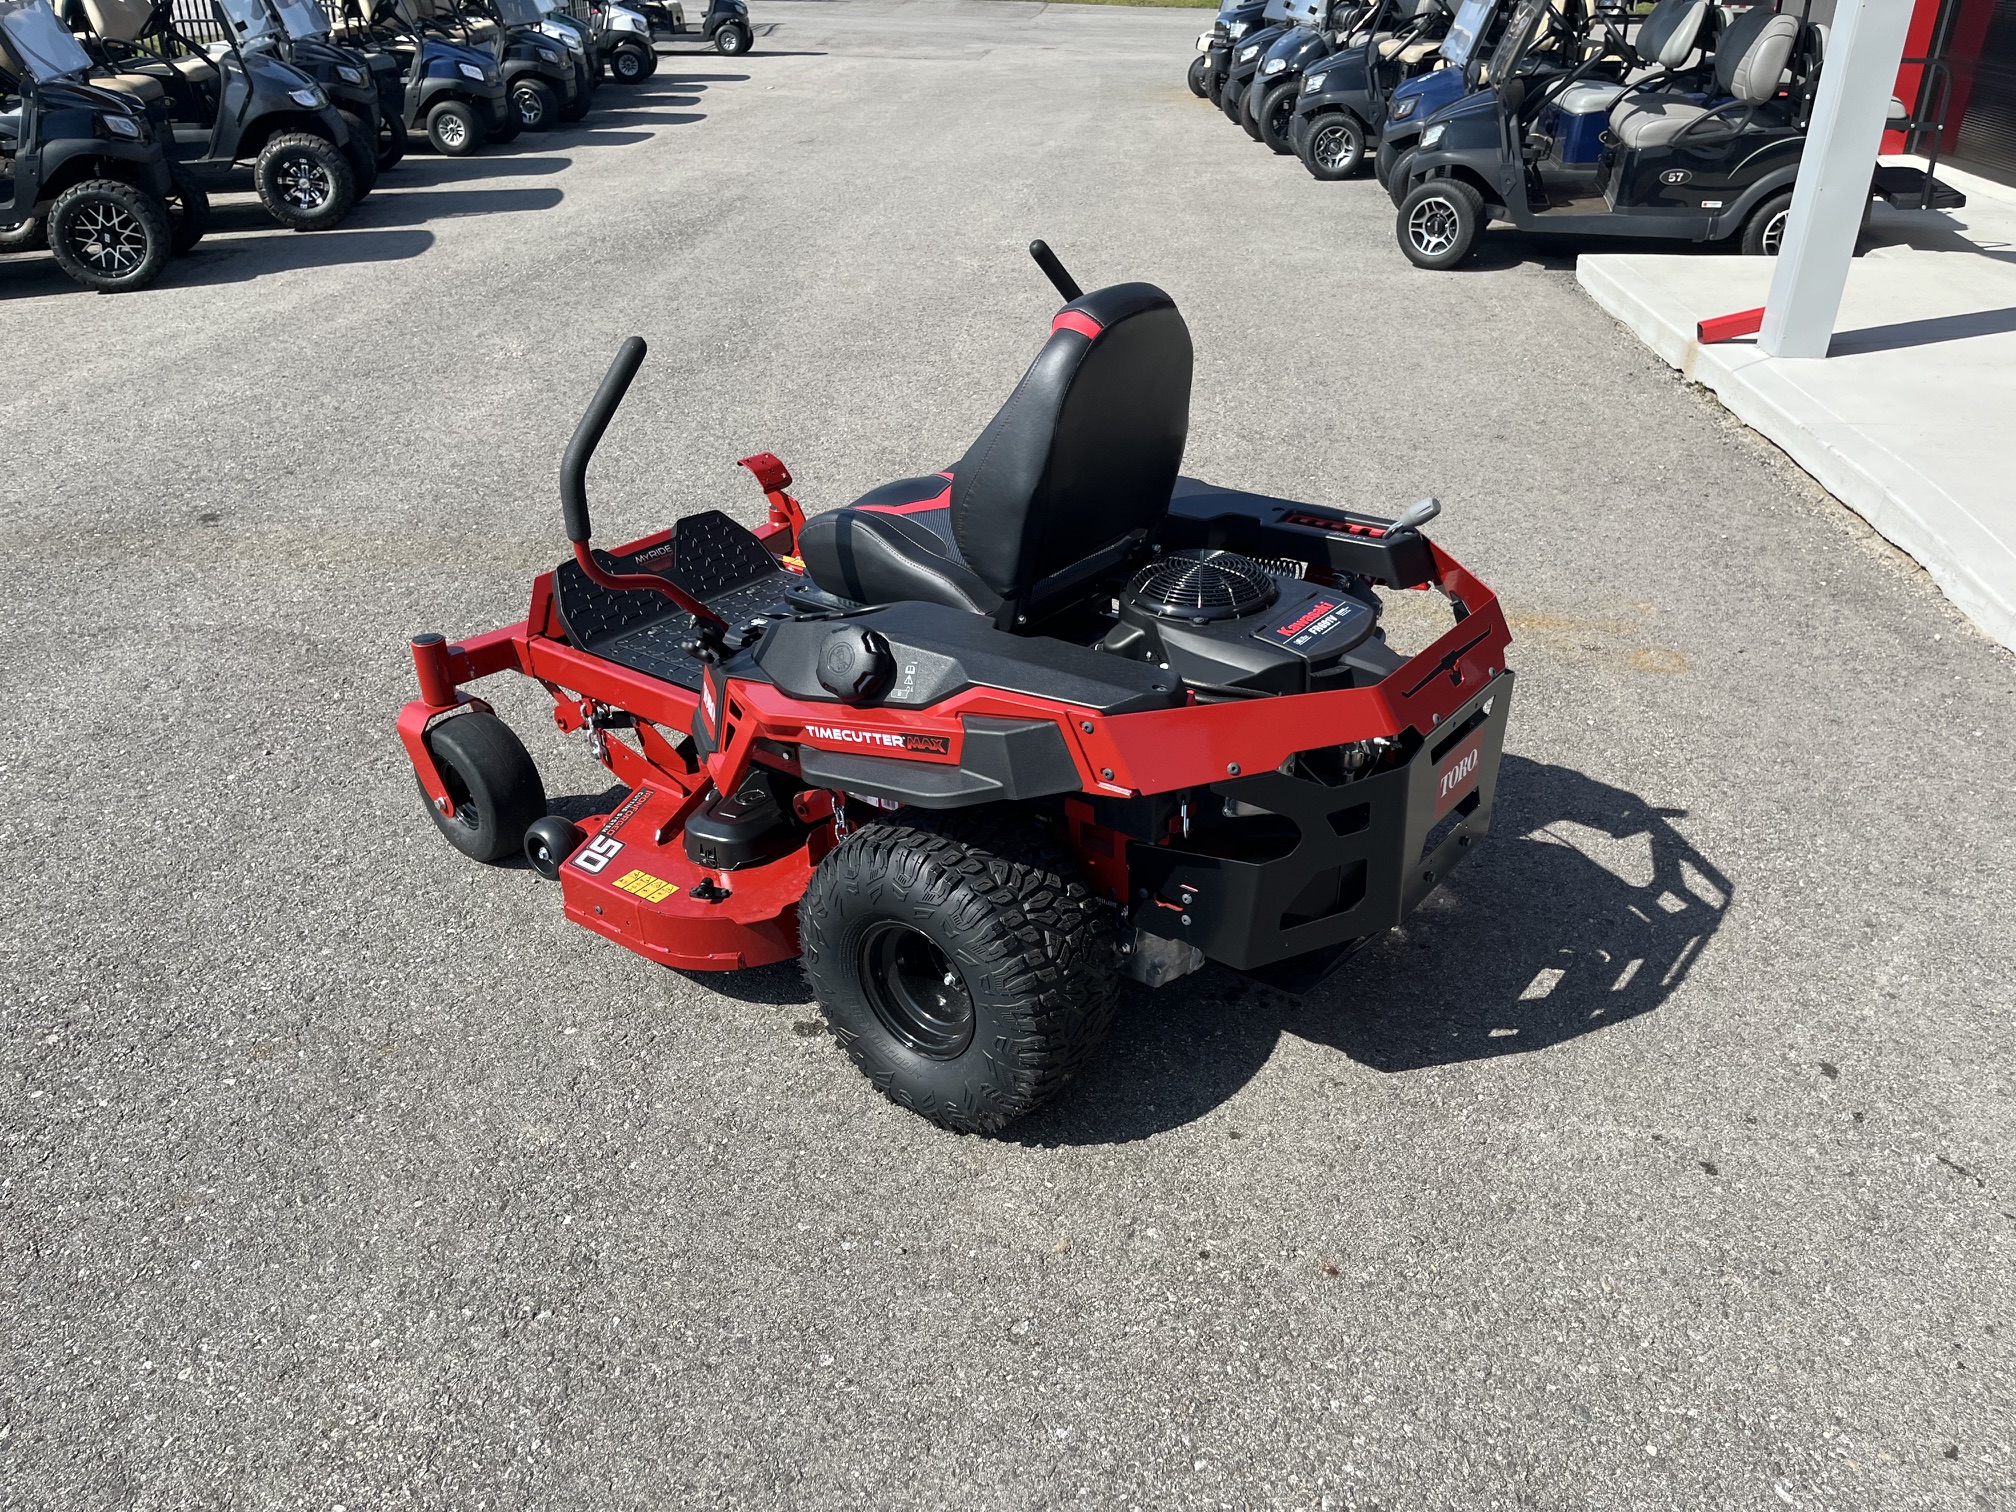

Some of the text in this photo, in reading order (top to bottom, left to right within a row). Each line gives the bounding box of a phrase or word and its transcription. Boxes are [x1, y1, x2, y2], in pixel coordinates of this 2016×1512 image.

[1668, 172, 1684, 182] 57
[1276, 601, 1335, 637] Kawasaki
[805, 725, 947, 754] TIMECUTTER MAX
[1440, 748, 1478, 798] TORO
[606, 790, 654, 836] IRONFORGED
[574, 834, 624, 873] 50
